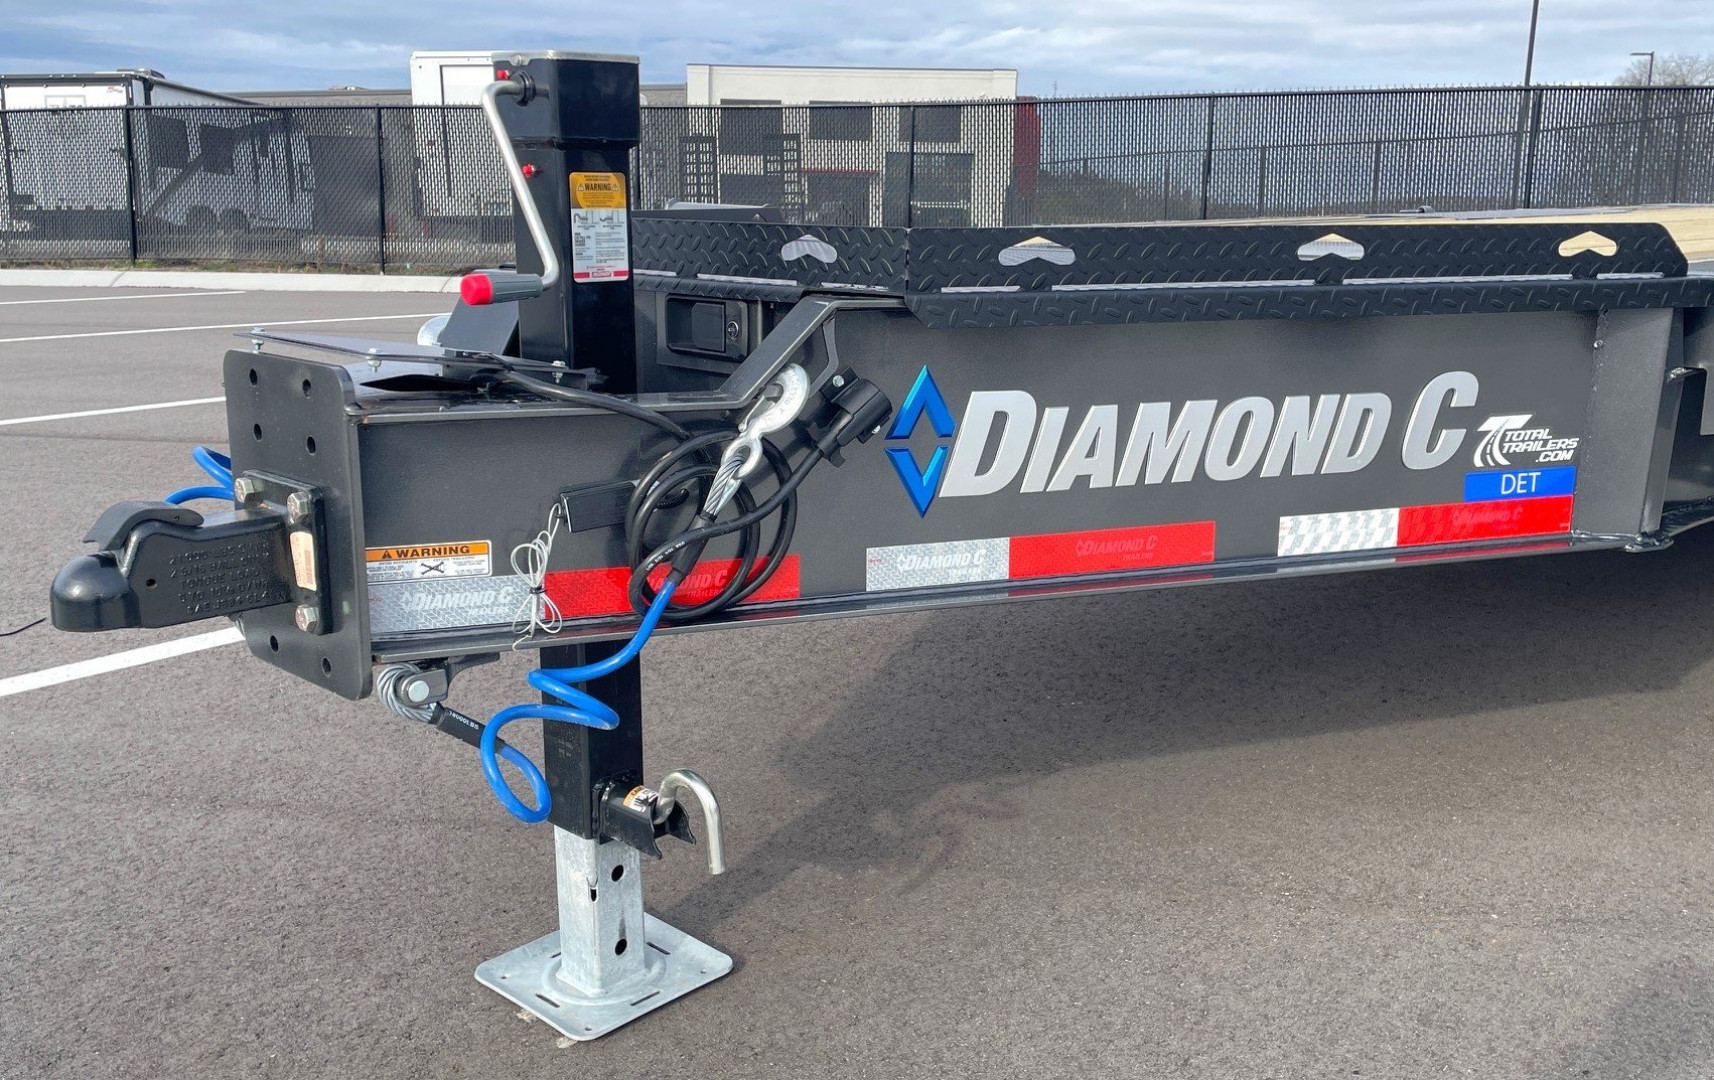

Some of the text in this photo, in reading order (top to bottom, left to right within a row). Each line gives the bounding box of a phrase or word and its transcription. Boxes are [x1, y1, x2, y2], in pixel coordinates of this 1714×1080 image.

[584, 183, 611, 191] WARNING
[940, 371, 1479, 498] DIAMOND C
[1503, 428, 1553, 443] TOTAL
[1502, 438, 1580, 453] TRAILERS
[1501, 472, 1542, 495] DET
[396, 545, 470, 558] WARNING
[1084, 537, 1147, 556] DIAMOND
[903, 548, 987, 571] DIAMOND C
[714, 569, 728, 587] C
[412, 586, 514, 610] DIAMOND C
